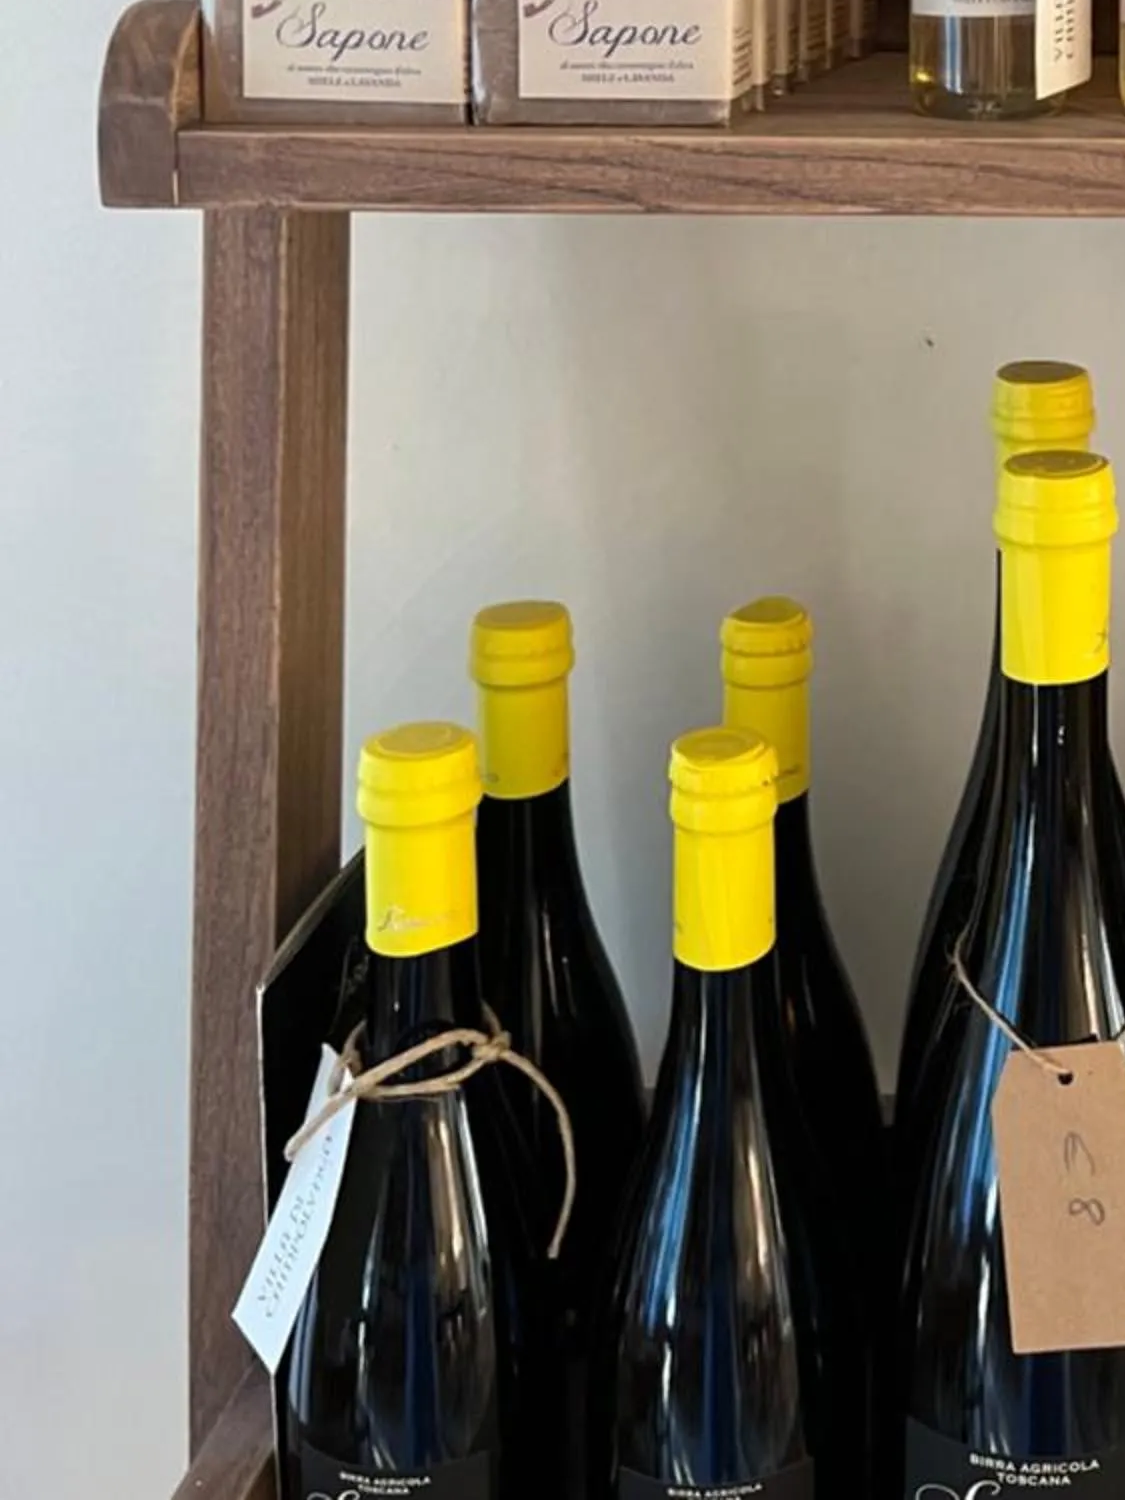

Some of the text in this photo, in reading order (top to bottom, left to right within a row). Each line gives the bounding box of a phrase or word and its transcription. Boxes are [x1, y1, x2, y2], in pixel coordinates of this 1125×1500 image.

[275, 1, 430, 62] Sapone
[548, 0, 703, 58] Sapone
[968, 1452, 1101, 1475] BIRRA AGRICOLA
[996, 1471, 1072, 1486] TOSCANA
